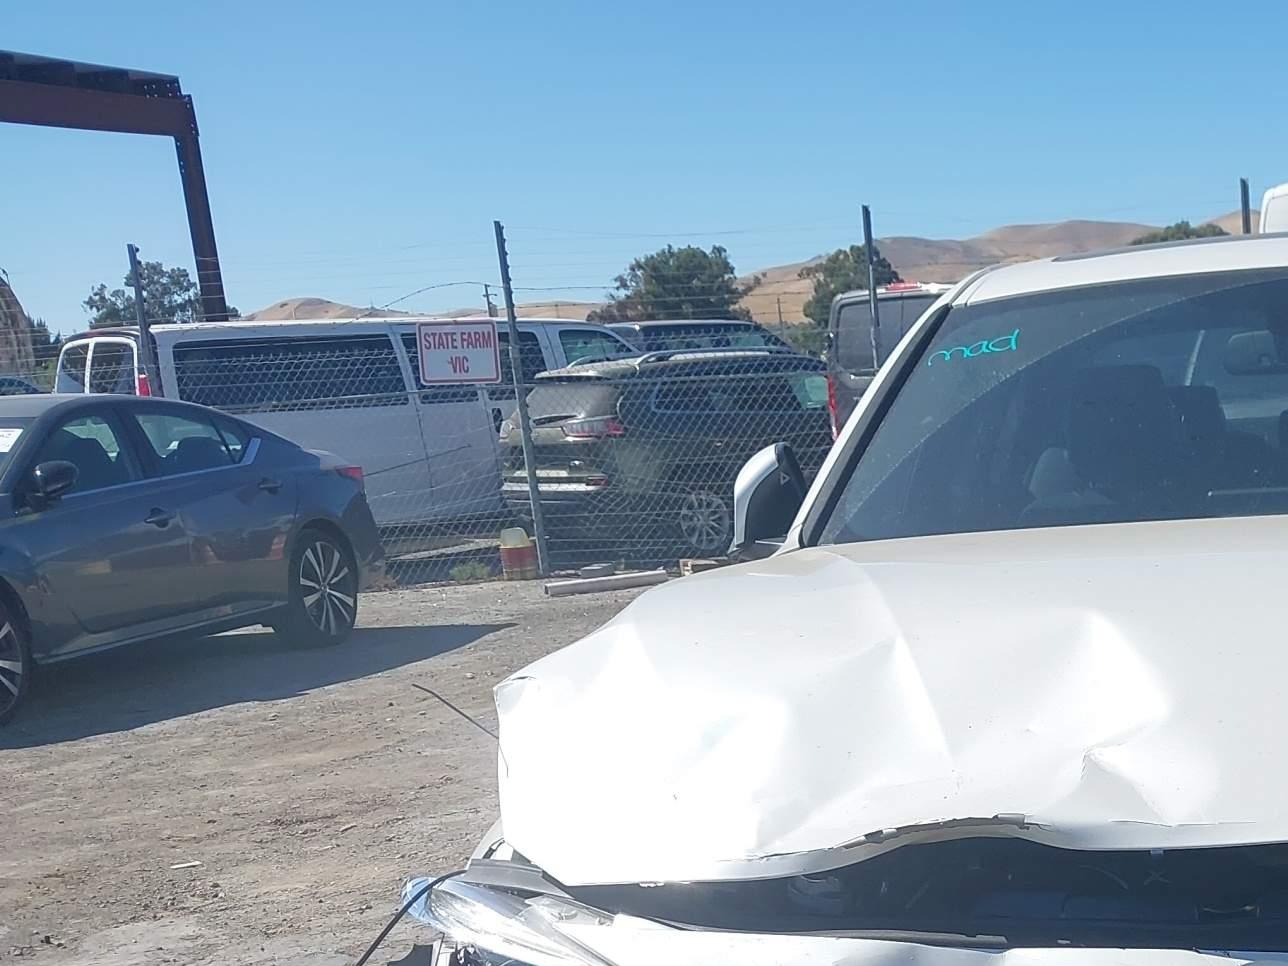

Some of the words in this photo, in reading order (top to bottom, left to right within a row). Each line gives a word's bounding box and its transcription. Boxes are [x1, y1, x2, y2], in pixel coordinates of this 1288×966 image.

[423, 331, 458, 350] STATE
[460, 331, 492, 349] FARM
[450, 355, 470, 374] VIC
